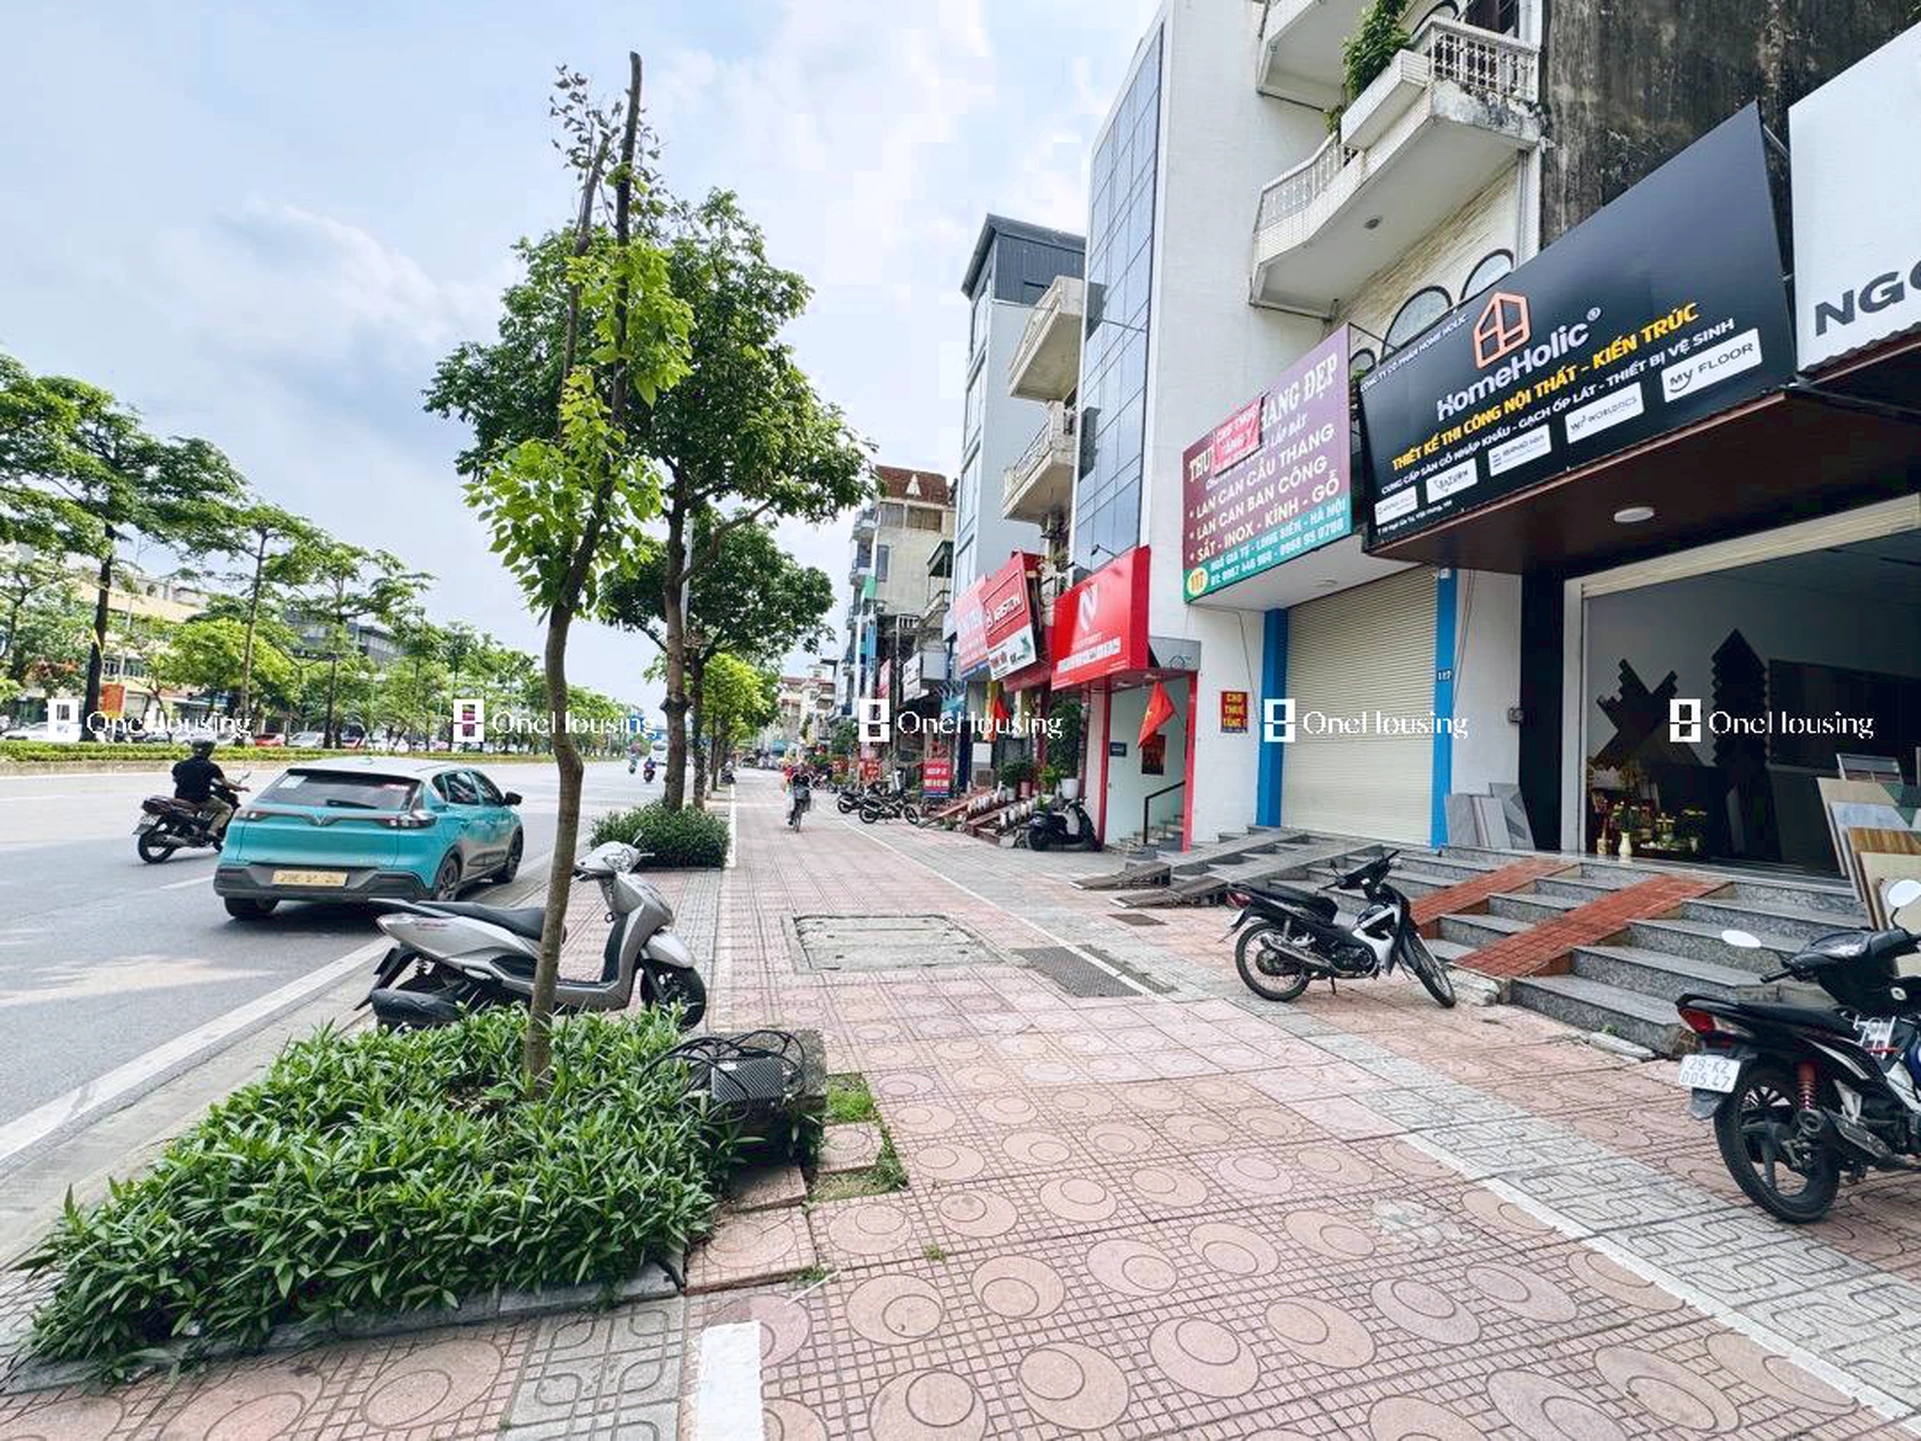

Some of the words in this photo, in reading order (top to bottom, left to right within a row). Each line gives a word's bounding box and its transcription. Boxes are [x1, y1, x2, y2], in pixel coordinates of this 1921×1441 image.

[1815, 260, 1921, 337] NG
[1303, 352, 1338, 401] ĐẸP
[1392, 444, 1423, 471] THIẾT
[1441, 426, 1462, 446] THI
[1463, 404, 1502, 434] CÔNG
[1503, 389, 1533, 414] NỘI
[1534, 365, 1578, 398] THẤT
[1593, 334, 1638, 370] KIẾN
[1639, 301, 1700, 344] TRÚC
[1436, 323, 1590, 422] HomeHolic
[1572, 384, 1597, 403] LÁT
[1606, 358, 1646, 388] THIẾT
[1668, 338, 1691, 358] VỆ
[1692, 318, 1735, 347] SINH
[1698, 342, 1754, 374] FLOOR
[1196, 496, 1216, 519] LAN
[1218, 479, 1244, 504] CAN
[1246, 457, 1275, 487] CẦU
[1280, 423, 1335, 468] THANG
[1196, 519, 1216, 540] LAN
[1219, 503, 1244, 527] CAN
[1248, 485, 1275, 512] BAN
[1278, 454, 1328, 494] CÔNG
[1197, 535, 1216, 562] SẮT
[1224, 521, 1254, 549] INOX
[1265, 499, 1299, 528] KÍNH
[1312, 469, 1340, 503] GỖ
